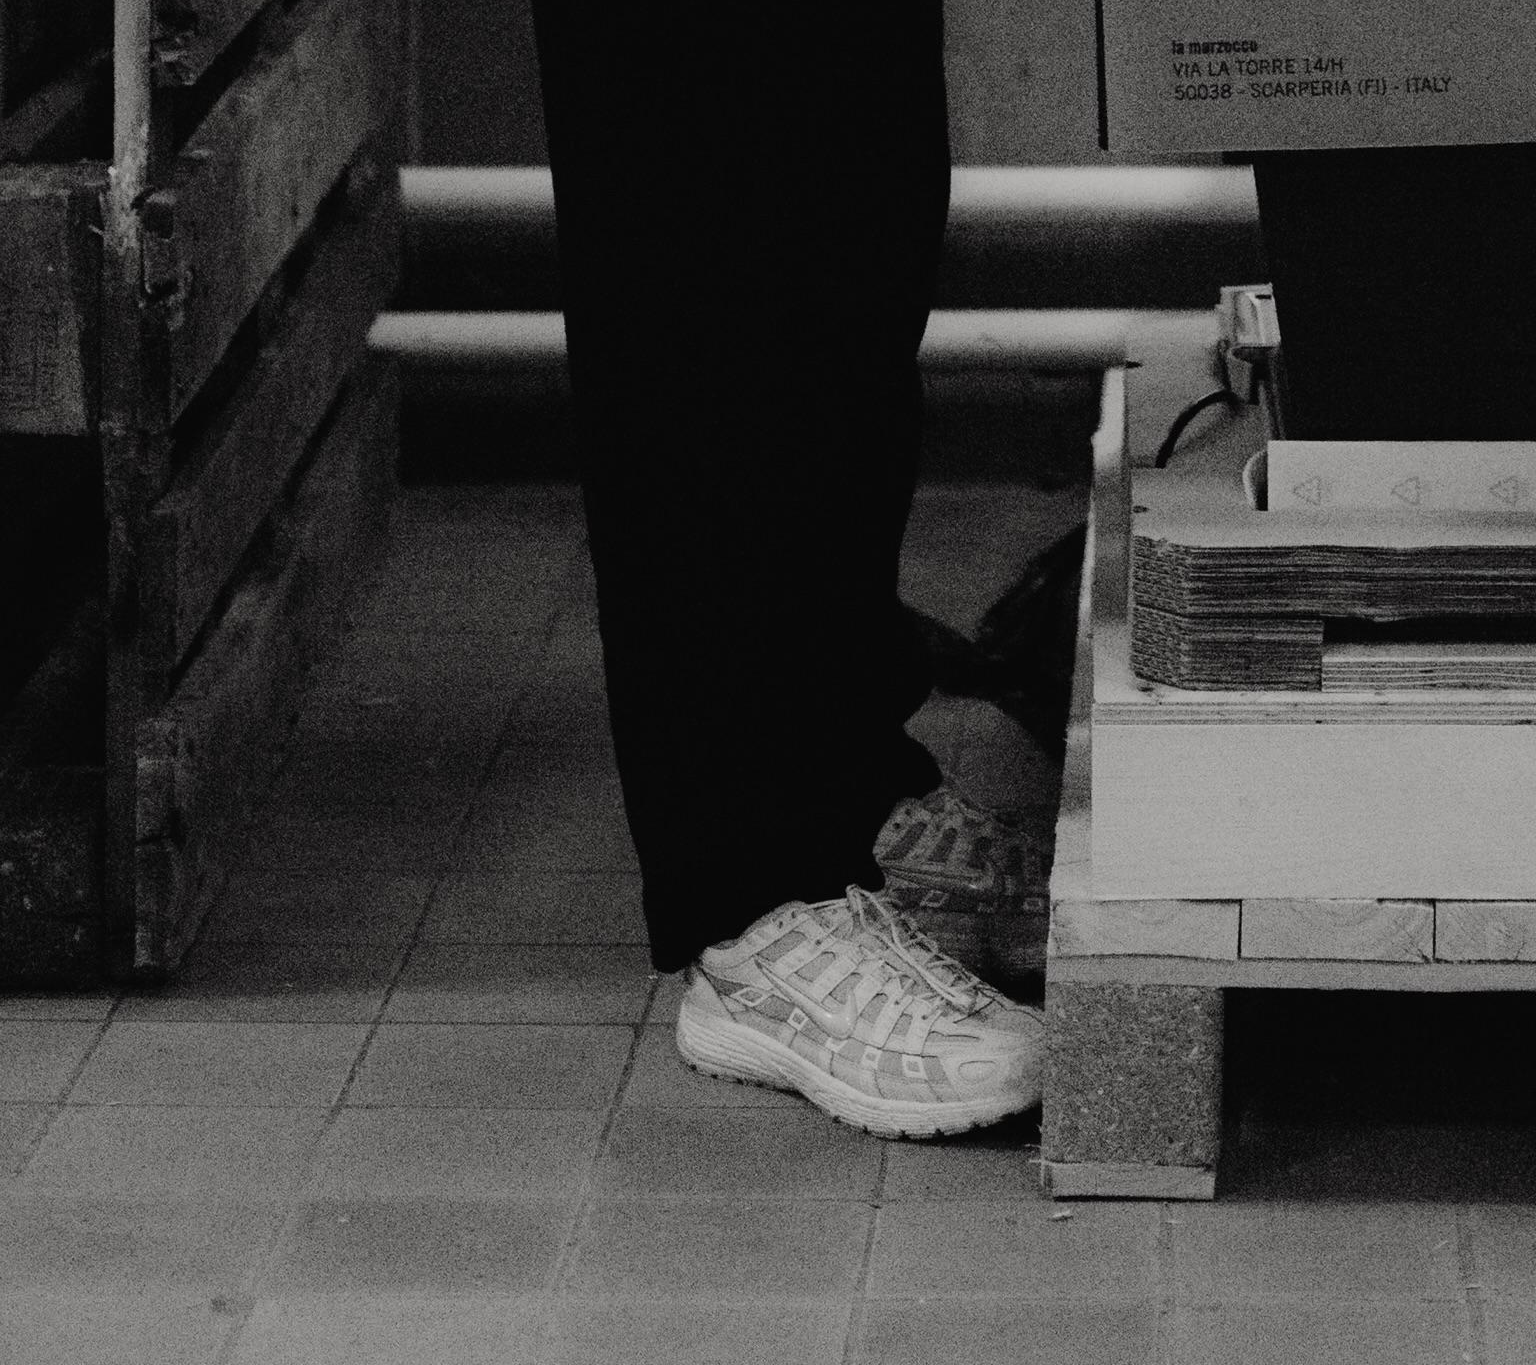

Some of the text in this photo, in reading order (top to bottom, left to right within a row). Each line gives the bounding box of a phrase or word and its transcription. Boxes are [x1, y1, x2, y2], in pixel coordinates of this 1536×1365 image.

[1172, 41, 1258, 55] la marzocco
[1173, 57, 1343, 78] VIA LA TORRE 14/H
[1174, 76, 1451, 101] 50038 SCARPERIA (FI) ITALY
